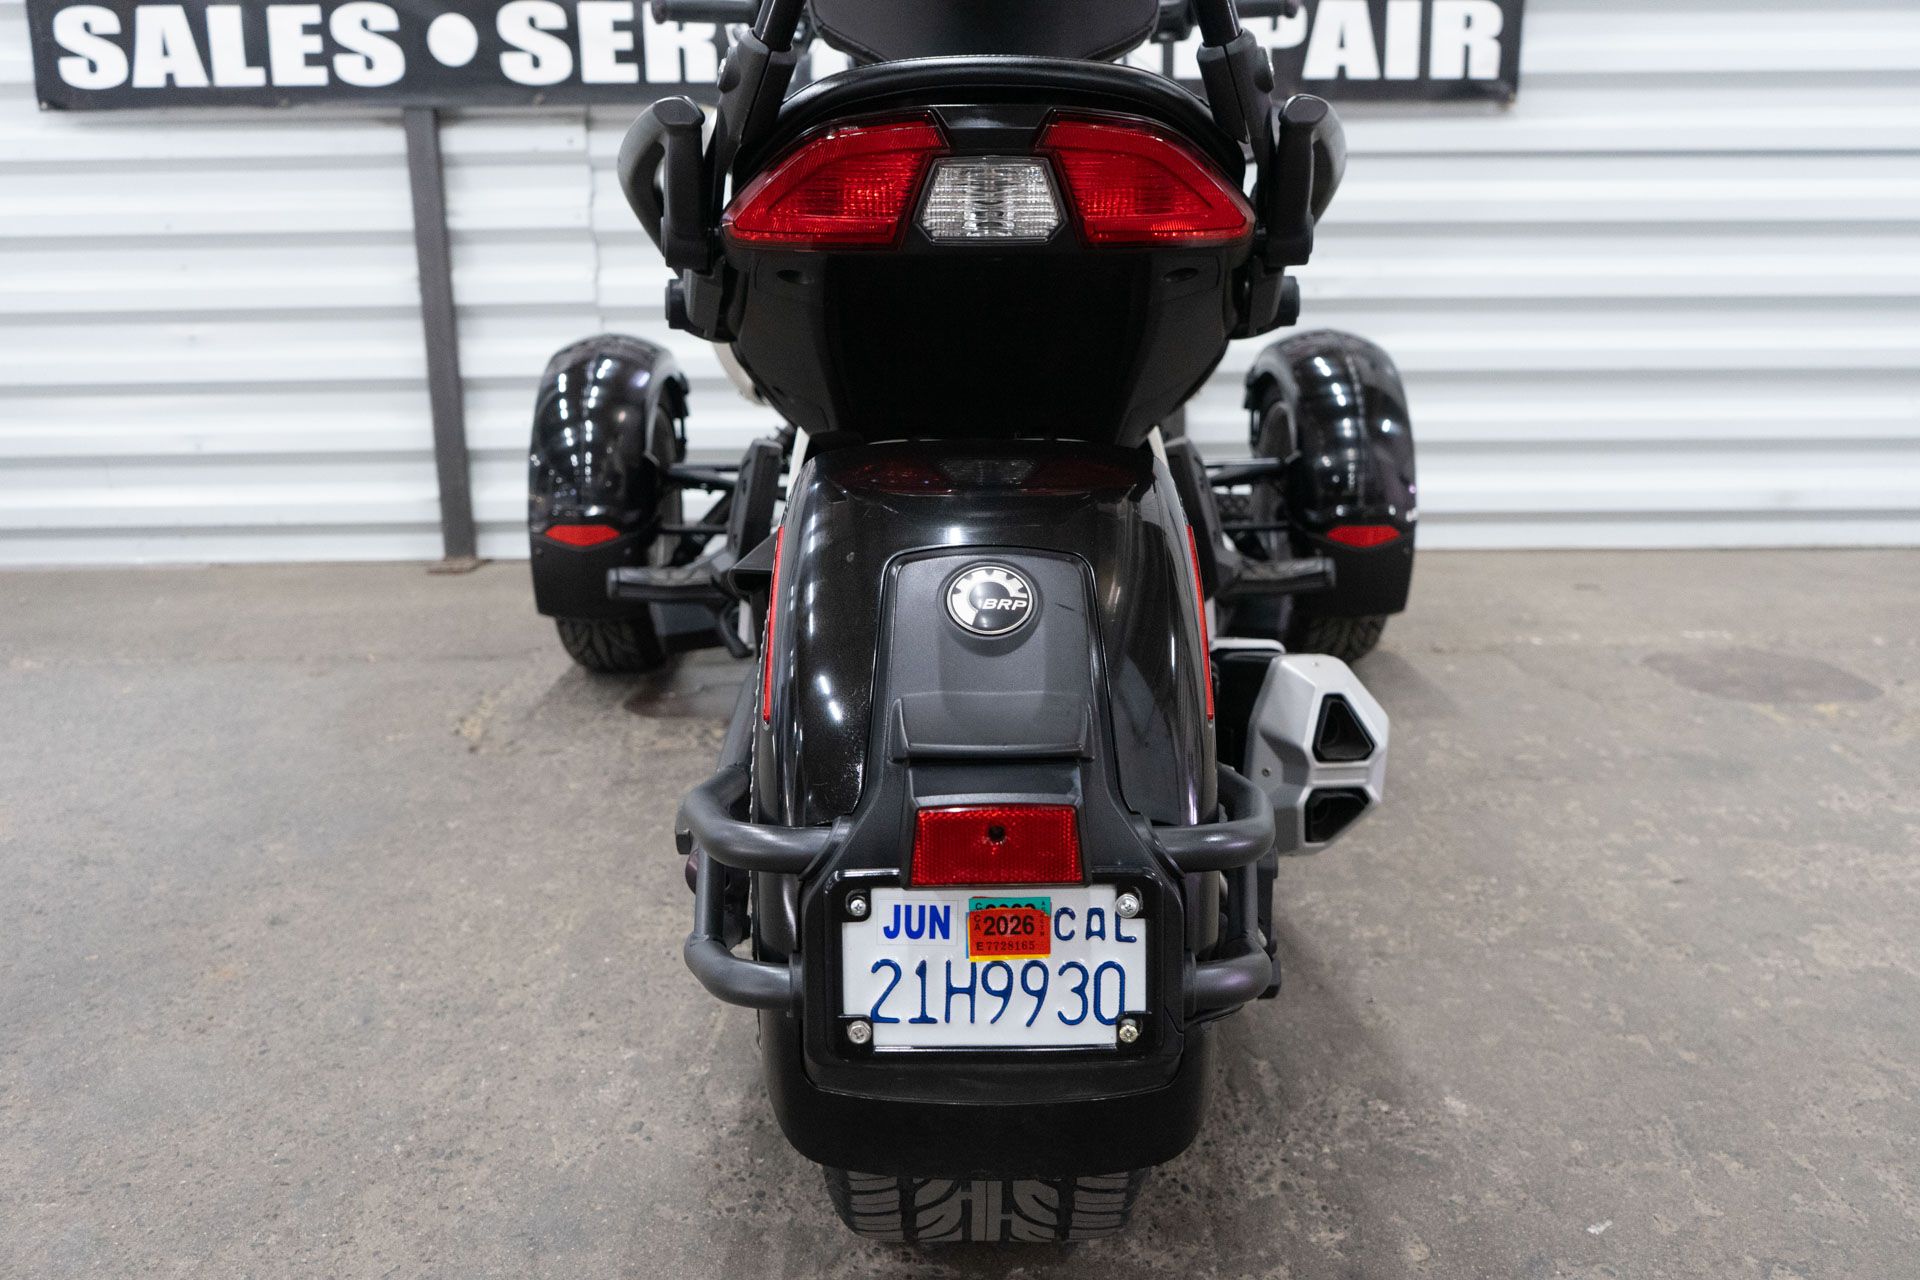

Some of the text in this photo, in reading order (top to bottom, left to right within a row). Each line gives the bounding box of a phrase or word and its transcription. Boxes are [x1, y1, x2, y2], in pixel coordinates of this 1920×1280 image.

[53, 1, 406, 90] SALES
[981, 598, 1027, 610] BRP
[883, 904, 950, 940] JUN
[1054, 906, 1137, 943] CAL
[983, 915, 1035, 936] 2026
[870, 959, 1126, 1027] 21H9930
